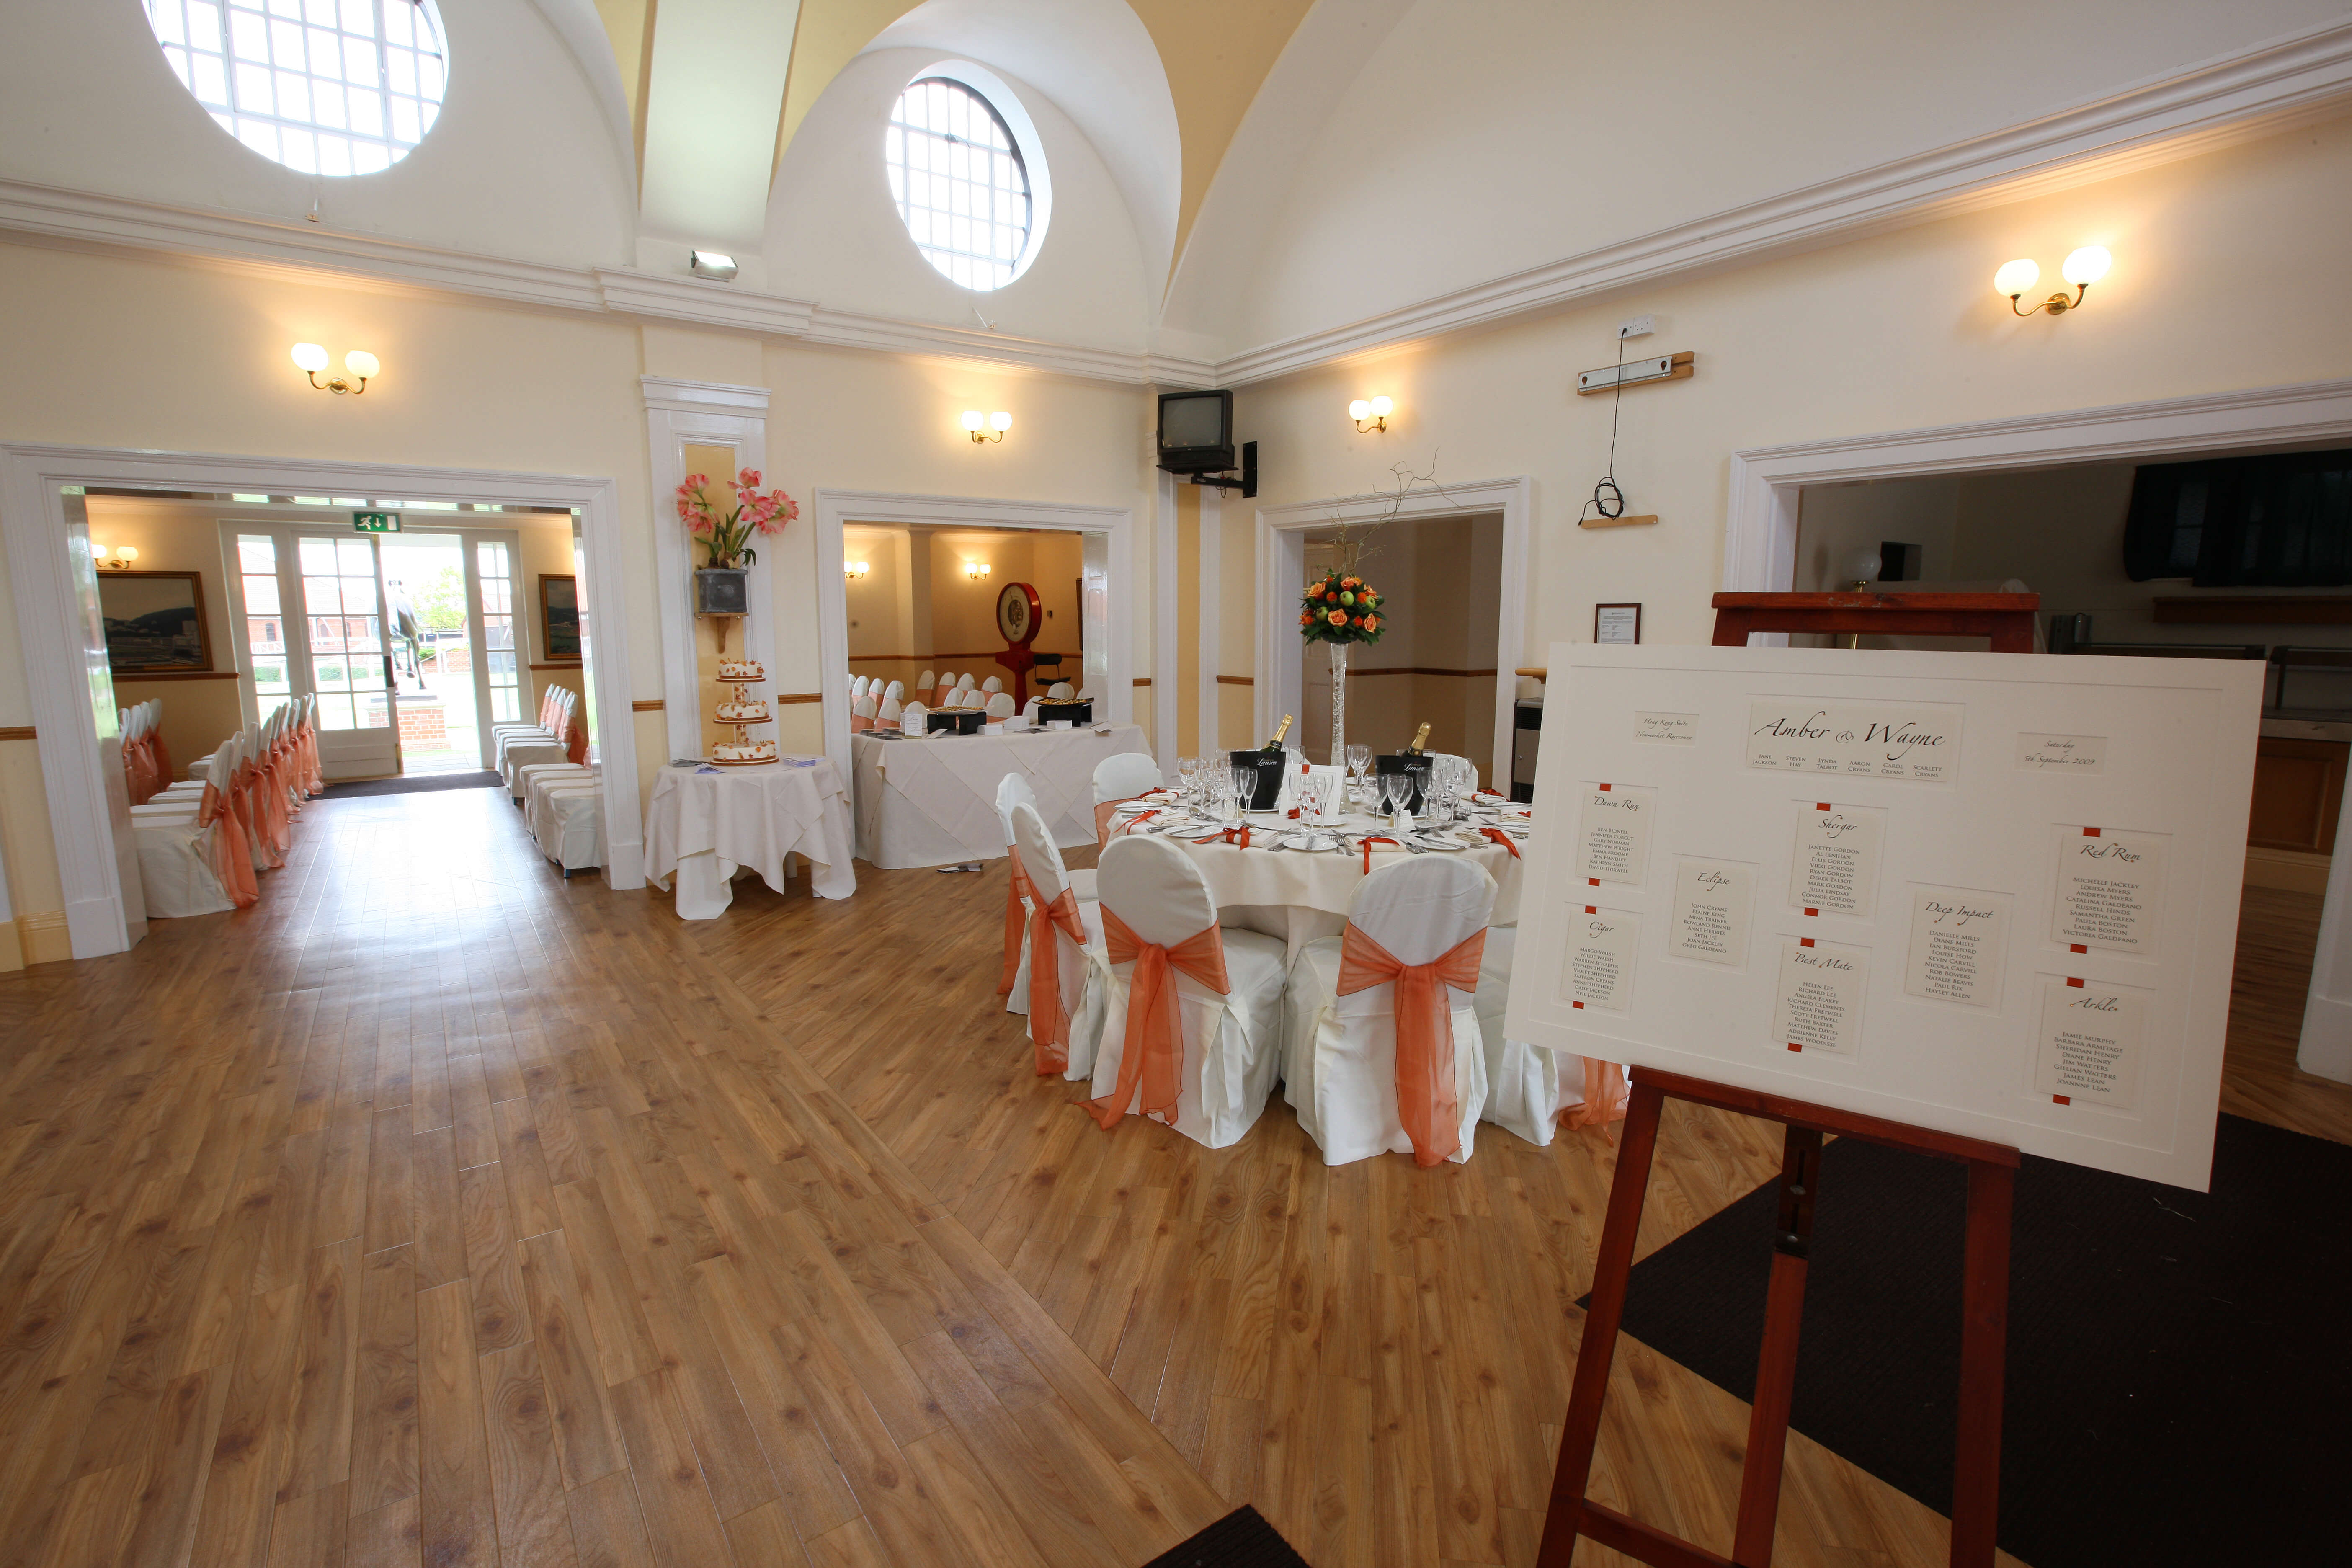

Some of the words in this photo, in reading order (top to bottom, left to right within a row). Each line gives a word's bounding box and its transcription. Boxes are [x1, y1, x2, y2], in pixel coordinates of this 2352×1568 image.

[1643, 717, 1658, 729] Hong
[1660, 719, 1674, 730] Kong
[1754, 711, 1830, 738] Amber
[1865, 722, 1945, 761] Wayne
[2044, 740, 2075, 753] Saturday
[2022, 753, 2040, 761] 5th
[2037, 755, 2071, 768] September
[1594, 796, 1618, 807] Dawn
[1622, 800, 1640, 811] Run
[1818, 815, 1857, 838] Shergar
[2080, 843, 2118, 858] Red
[2112, 848, 2142, 863] Rum
[1697, 871, 1730, 891] Eclipse
[1925, 901, 1954, 923] Deep
[1957, 905, 1993, 926] Impact
[1589, 921, 1614, 939] Cigar
[1795, 952, 1818, 965] Best
[1819, 958, 1854, 971] Mate
[2070, 997, 2118, 1012] Arkle
